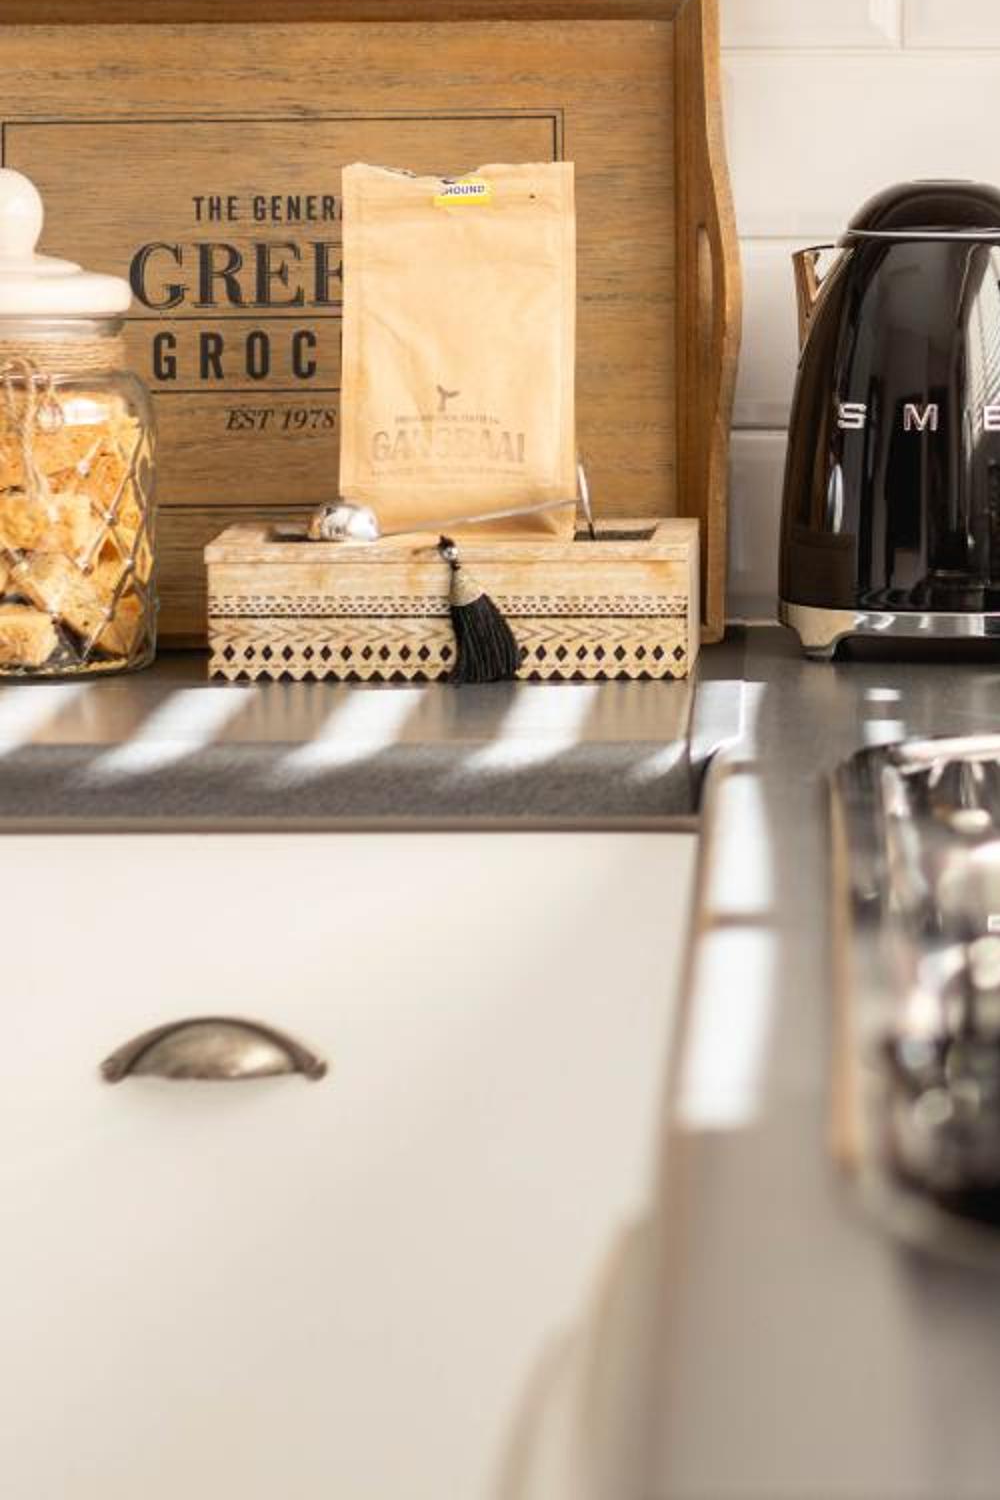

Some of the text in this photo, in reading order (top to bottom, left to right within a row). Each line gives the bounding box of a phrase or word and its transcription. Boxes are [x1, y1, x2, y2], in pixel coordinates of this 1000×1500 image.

[192, 194, 343, 222] THE GENER
[153, 330, 343, 382] GROC
[225, 408, 337, 432] EST 1978
